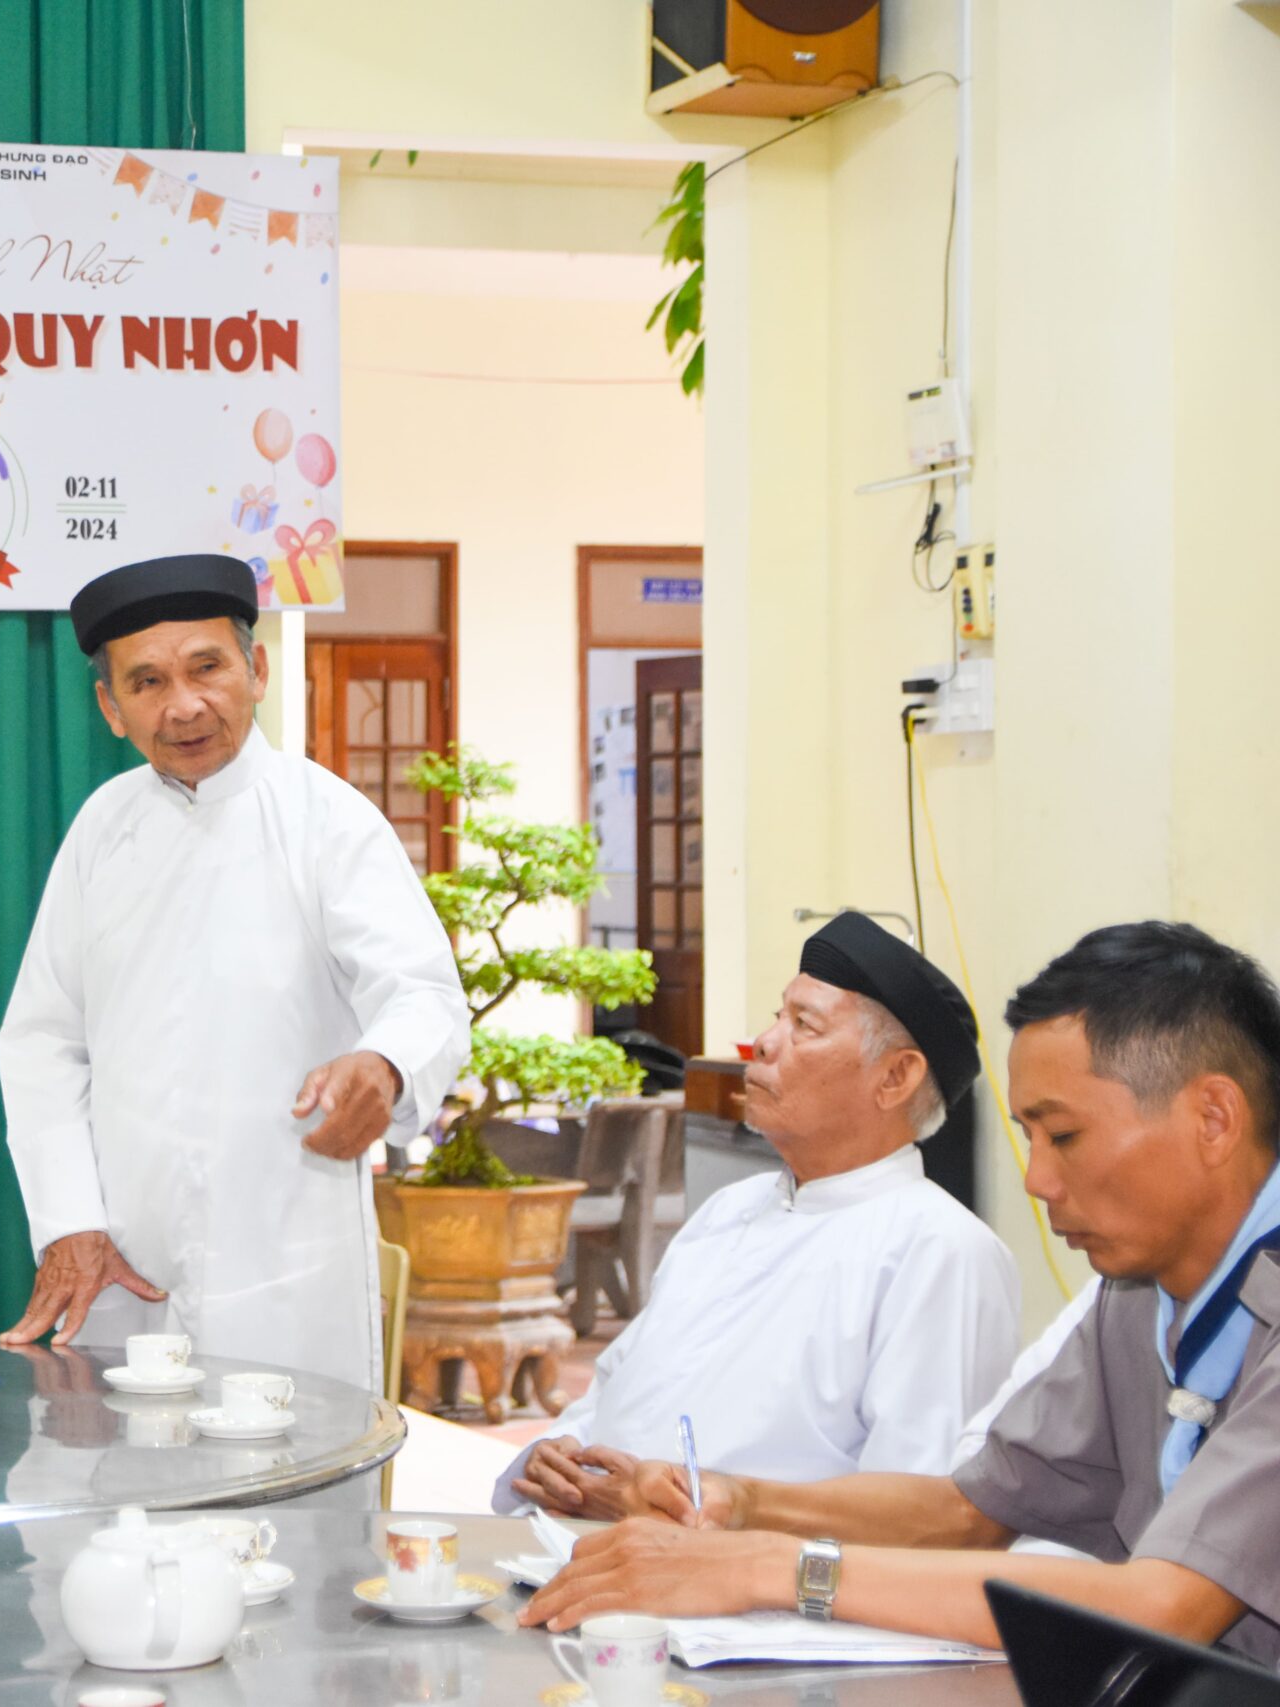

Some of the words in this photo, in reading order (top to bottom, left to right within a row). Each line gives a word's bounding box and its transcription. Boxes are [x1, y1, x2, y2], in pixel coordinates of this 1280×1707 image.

[0, 169, 47, 181] SINH
[19, 233, 144, 290] Nhật
[120, 309, 299, 373] NHƠN
[64, 476, 118, 500] 02-11
[65, 518, 118, 541] 2024
